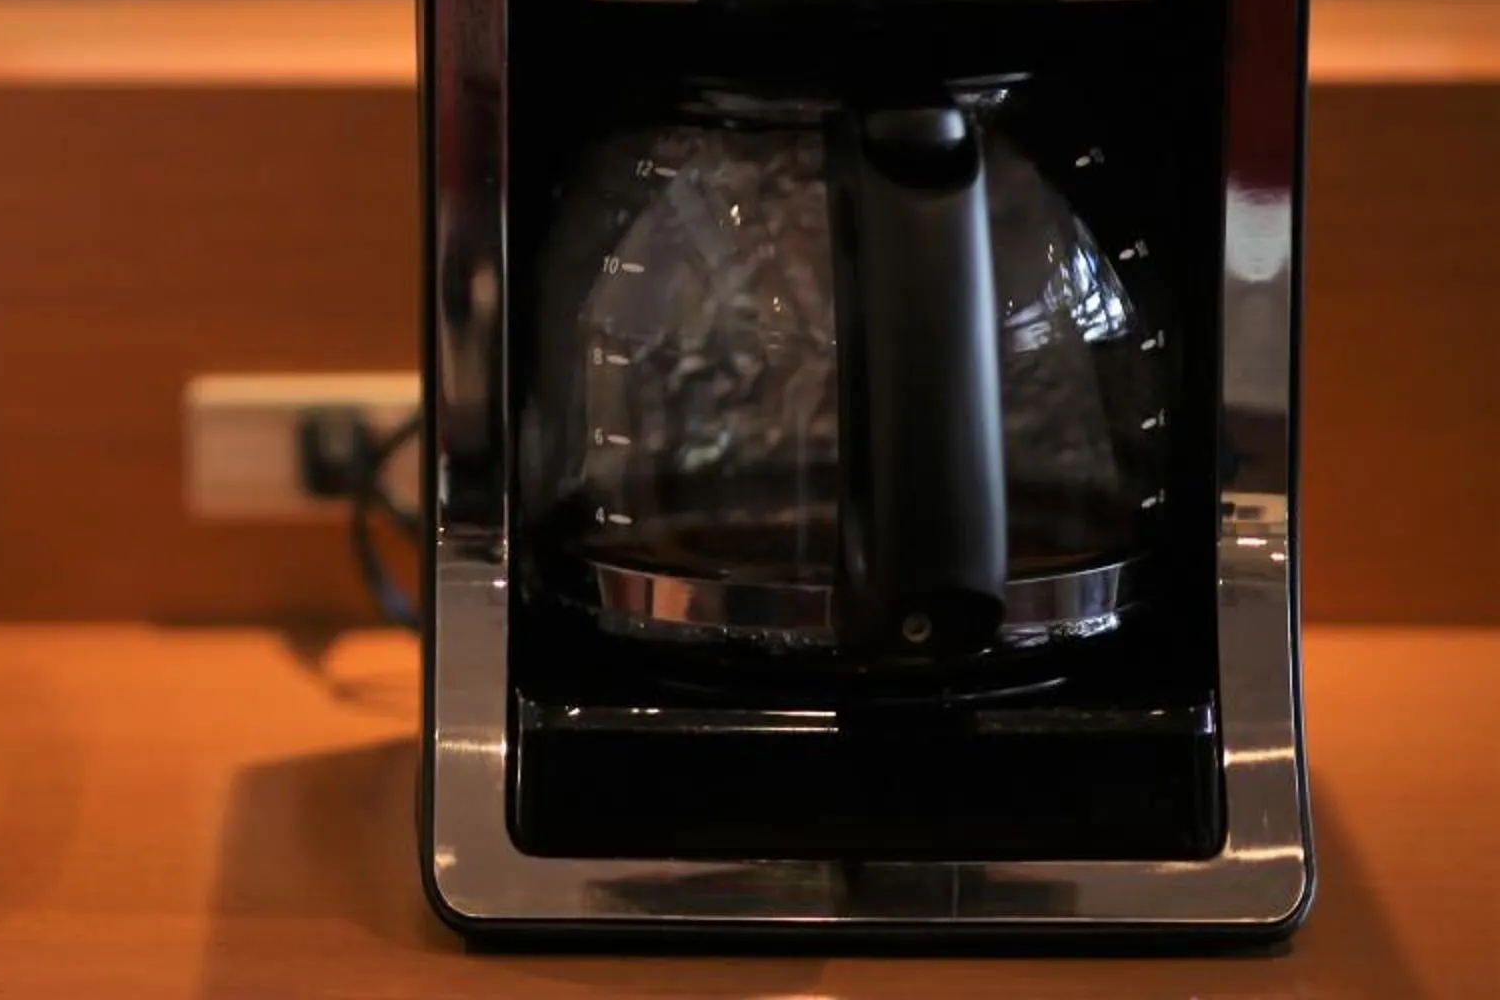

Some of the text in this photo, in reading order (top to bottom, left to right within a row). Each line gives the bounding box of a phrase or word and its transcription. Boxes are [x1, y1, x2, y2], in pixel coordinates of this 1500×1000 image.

[635, 159, 654, 178] 12
[603, 255, 620, 275] 10
[592, 347, 603, 366] 8
[595, 505, 605, 525] 4
